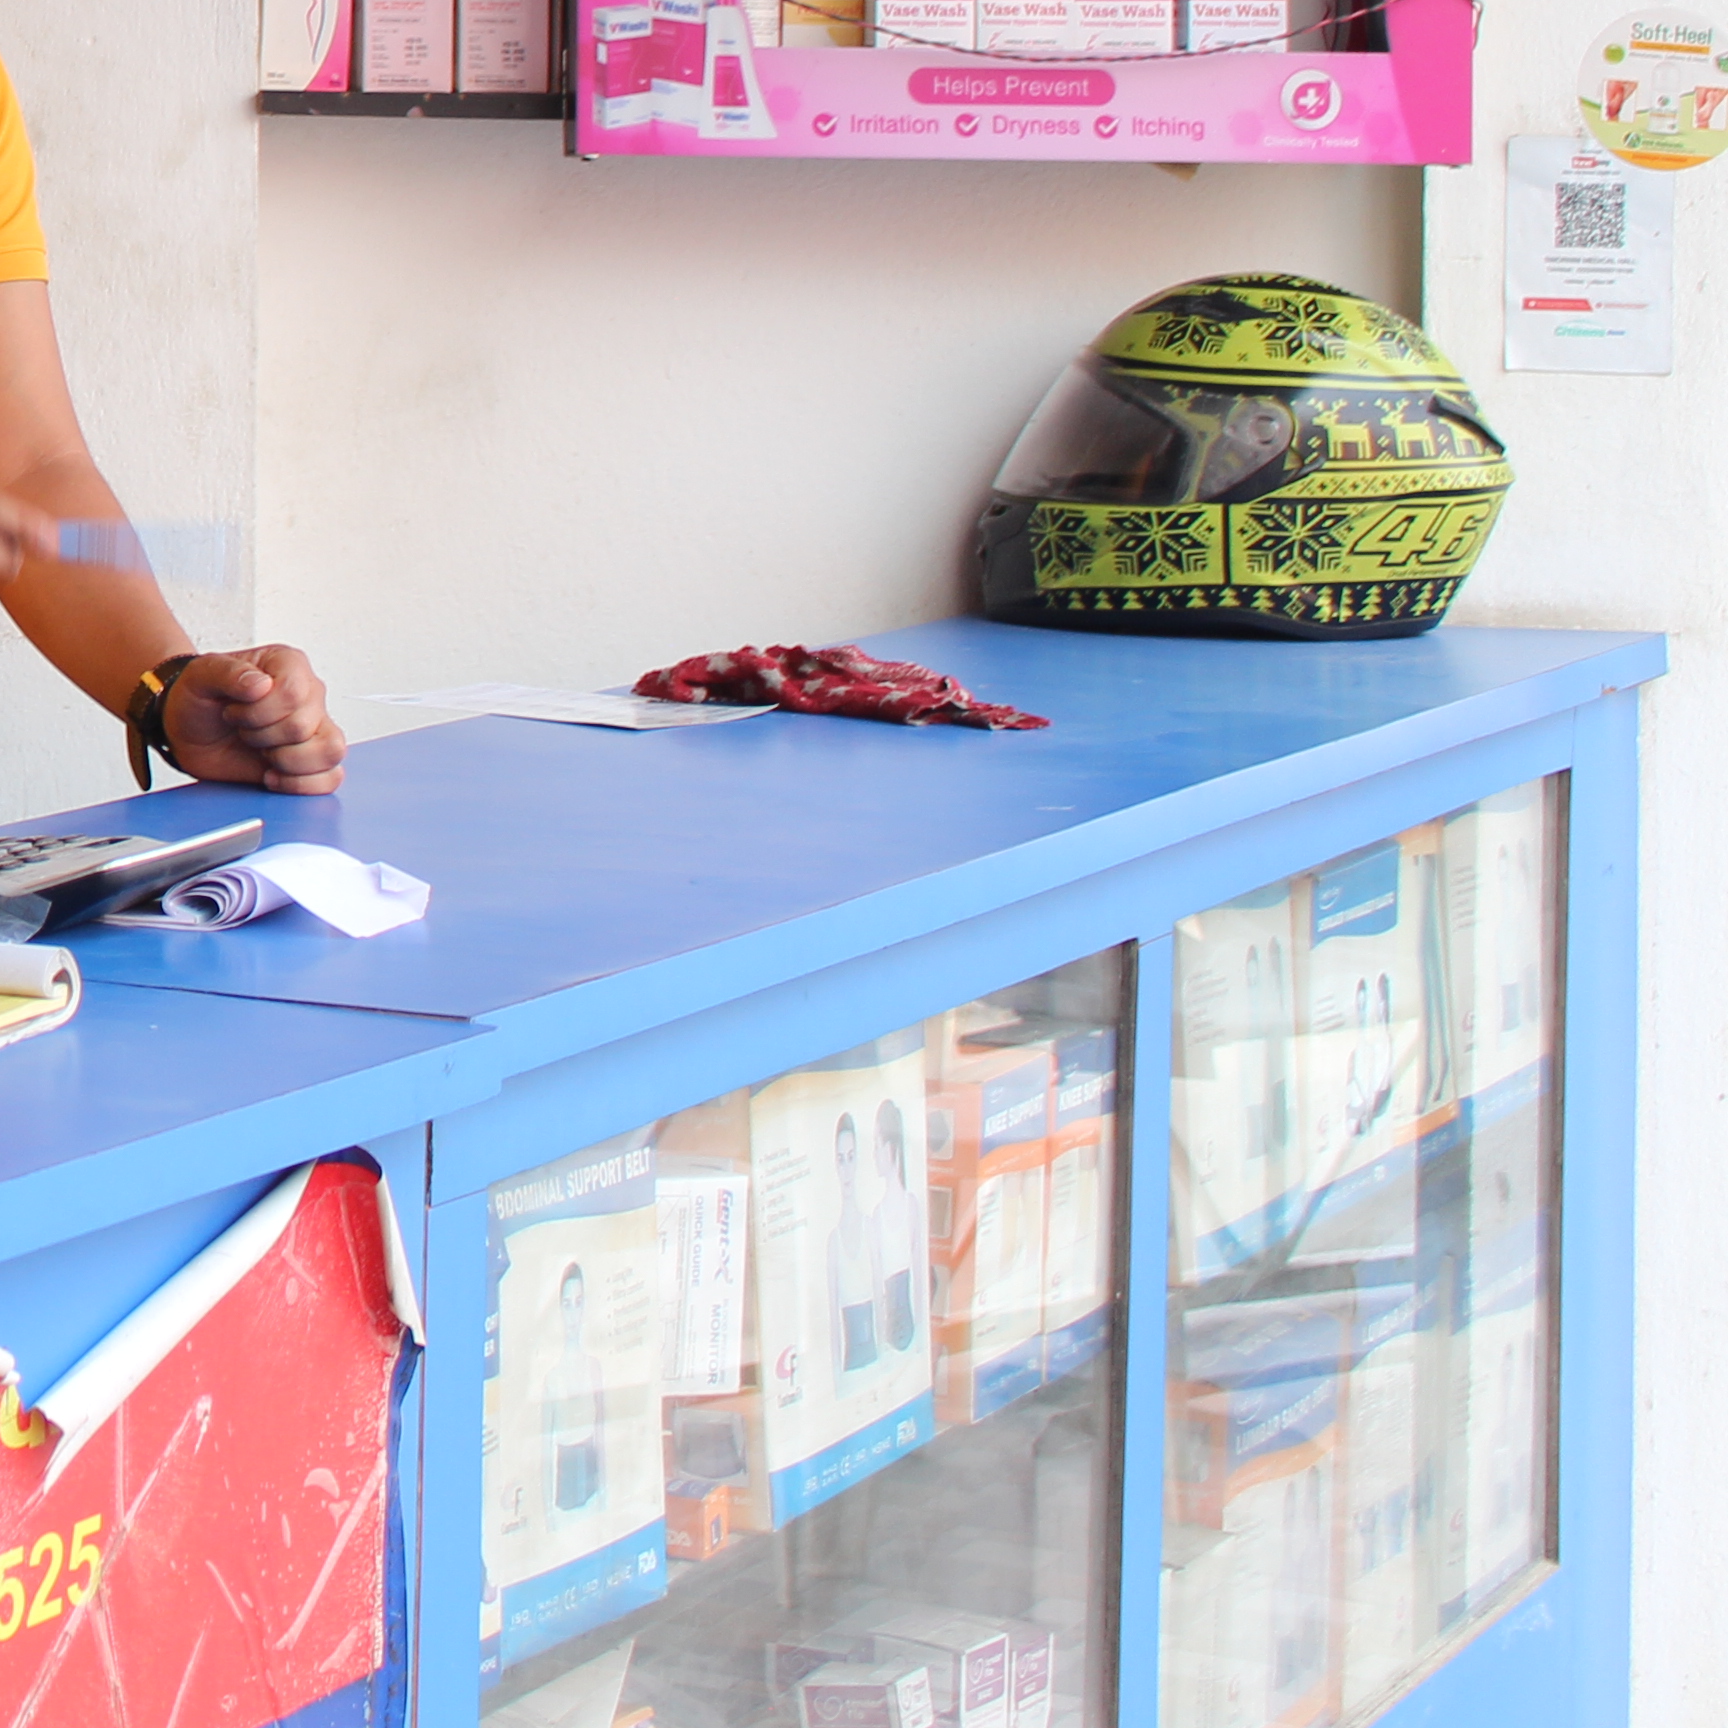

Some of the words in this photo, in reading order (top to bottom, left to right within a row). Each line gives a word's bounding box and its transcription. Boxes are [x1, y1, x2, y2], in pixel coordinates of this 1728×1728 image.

[1630, 21, 1713, 46] Soft-Heel
[932, 76, 998, 99] Helps
[1004, 76, 1090, 98] Prevent
[848, 112, 940, 136] Irritation
[991, 116, 1081, 138] Dryness
[1130, 116, 1206, 141] Itching
[1347, 502, 1496, 569] 46
[565, 1160, 623, 1200] SUPPORT
[623, 1145, 652, 1180] BELT
[694, 1194, 705, 1238] QUICK
[690, 1243, 701, 1288] GUIDE
[706, 1303, 722, 1386] MONITOR
